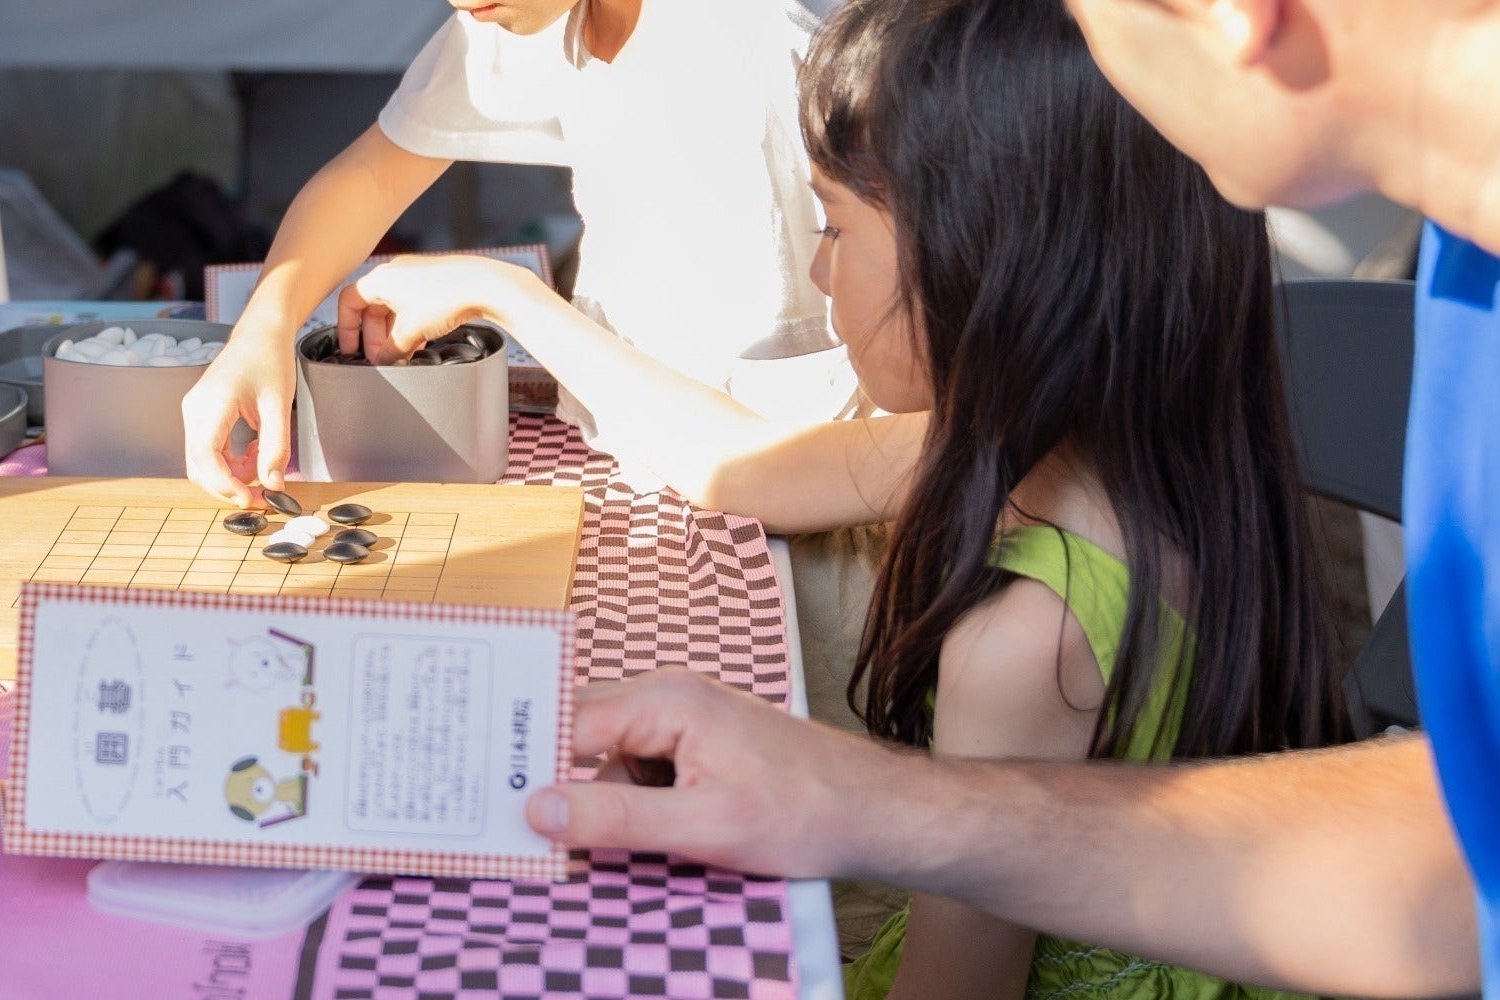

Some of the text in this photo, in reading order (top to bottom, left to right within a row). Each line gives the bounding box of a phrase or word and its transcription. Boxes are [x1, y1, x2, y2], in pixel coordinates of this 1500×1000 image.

[96, 678, 132, 765] 囲碁
[167, 643, 195, 803] 入門ガイド
